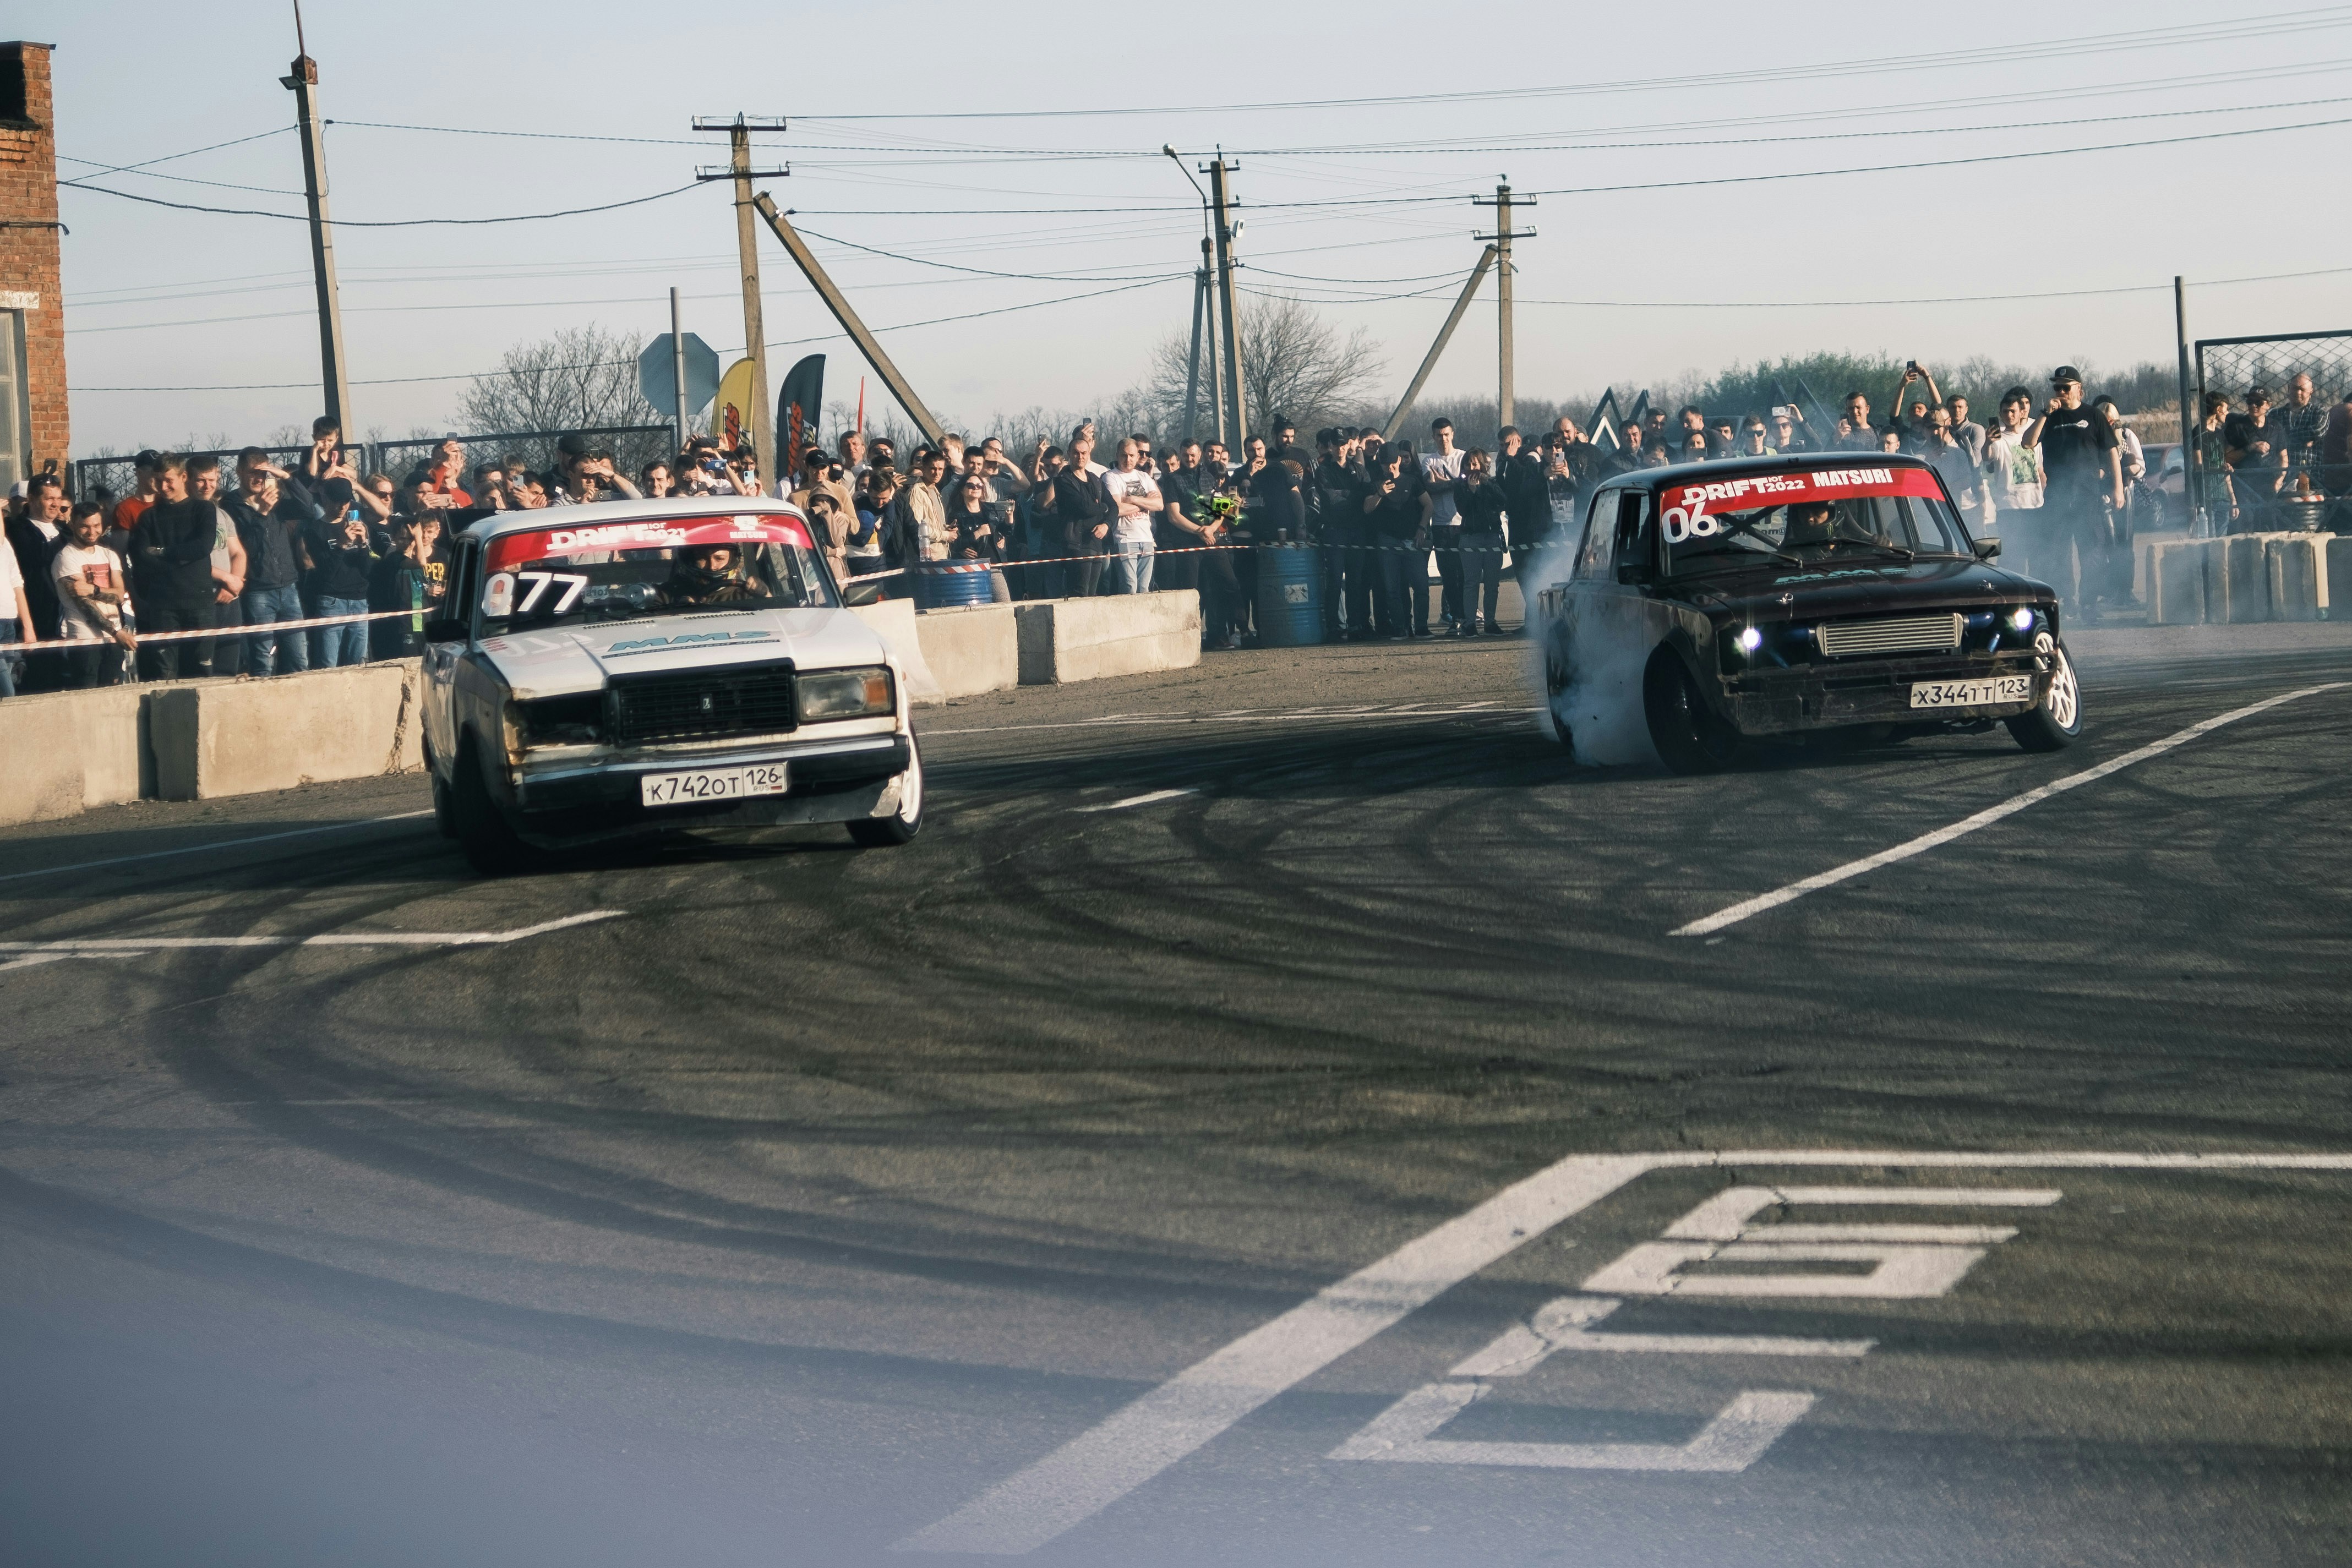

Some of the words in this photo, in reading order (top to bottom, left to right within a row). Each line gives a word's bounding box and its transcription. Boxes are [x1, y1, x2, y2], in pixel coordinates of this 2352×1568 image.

[1765, 480, 1806, 493] 2022
[1812, 468, 1893, 487] MATSURI
[1682, 477, 1767, 506] DRIFT
[1661, 501, 1717, 544] 06
[546, 523, 648, 550] DRIFT
[729, 531, 768, 539] MATSURI
[423, 562, 445, 582] PER
[608, 631, 771, 652] MMS
[1998, 679, 2027, 694] 123
[746, 767, 779, 785] 126
